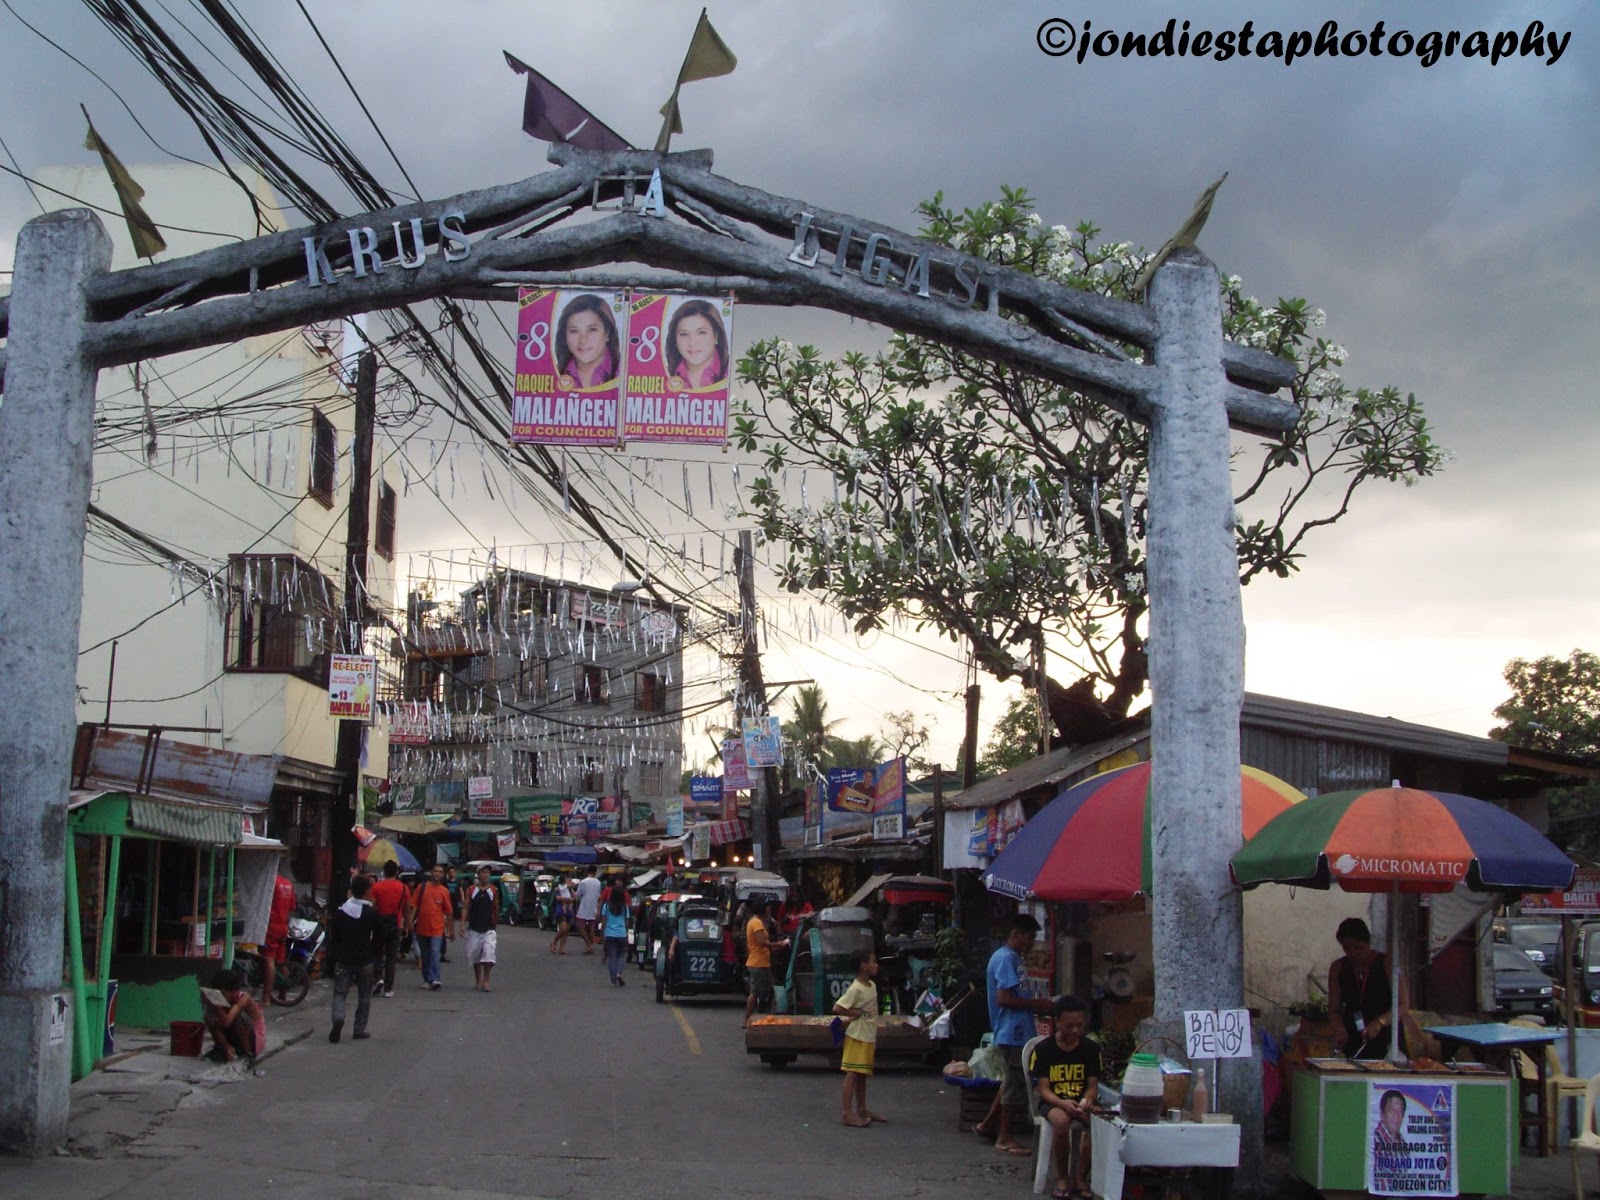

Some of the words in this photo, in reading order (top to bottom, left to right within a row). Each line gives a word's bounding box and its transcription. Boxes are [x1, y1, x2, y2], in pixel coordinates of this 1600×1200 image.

[302, 210, 471, 288] KRUS
[787, 211, 983, 308] LIGAS
[524, 321, 549, 361] 8
[635, 325, 660, 363] 8
[515, 374, 555, 394] RAQUEL
[627, 376, 665, 394] RAQUEL
[514, 392, 617, 427] MALAÑGEN
[625, 393, 725, 427] MALAÑGEN
[513, 427, 532, 435] FOR
[535, 427, 616, 438] COUNCILOR
[624, 425, 643, 434] FOR
[646, 425, 725, 437] COUNCILOR
[1361, 858, 1463, 877] MICROMATIC
[1563, 893, 1597, 902] DANTE
[690, 957, 716, 973] 222
[1189, 1011, 1243, 1033] BALOT
[1189, 1026, 1244, 1057] PENOY
[1378, 1157, 1411, 1169] ROLAND
[1414, 1158, 1435, 1169] JOTA
[1392, 1179, 1425, 1191] QUEZON
